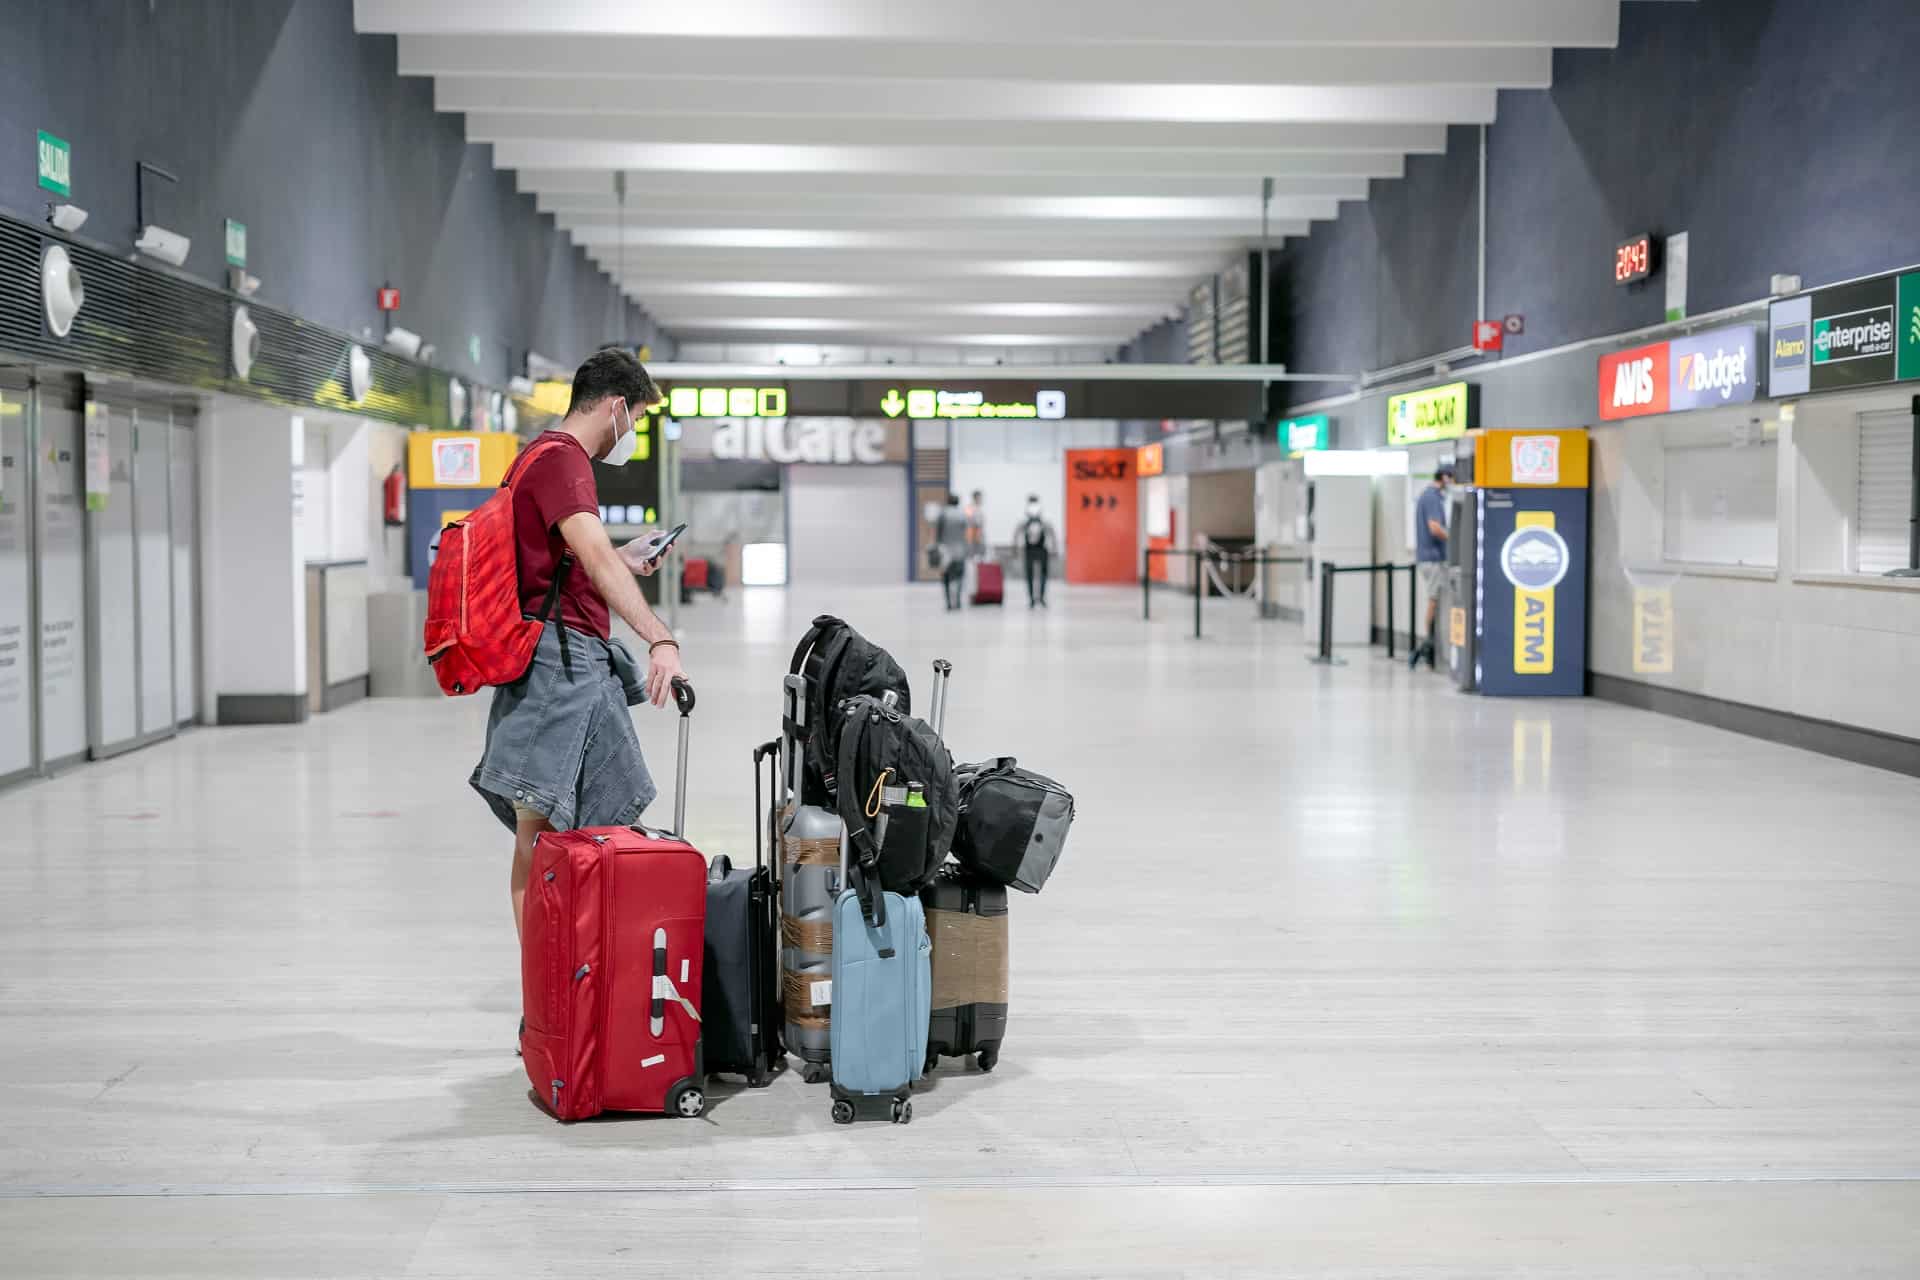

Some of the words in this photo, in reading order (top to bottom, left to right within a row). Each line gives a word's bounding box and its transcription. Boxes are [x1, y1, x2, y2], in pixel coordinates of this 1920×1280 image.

[40, 139, 70, 187] SALIDA
[1776, 339, 1804, 357] Alamo
[1815, 318, 1891, 352] enterprise
[1612, 357, 1653, 407] AVIS
[1694, 346, 1747, 399] Budget
[1523, 596, 1545, 664] ATM
